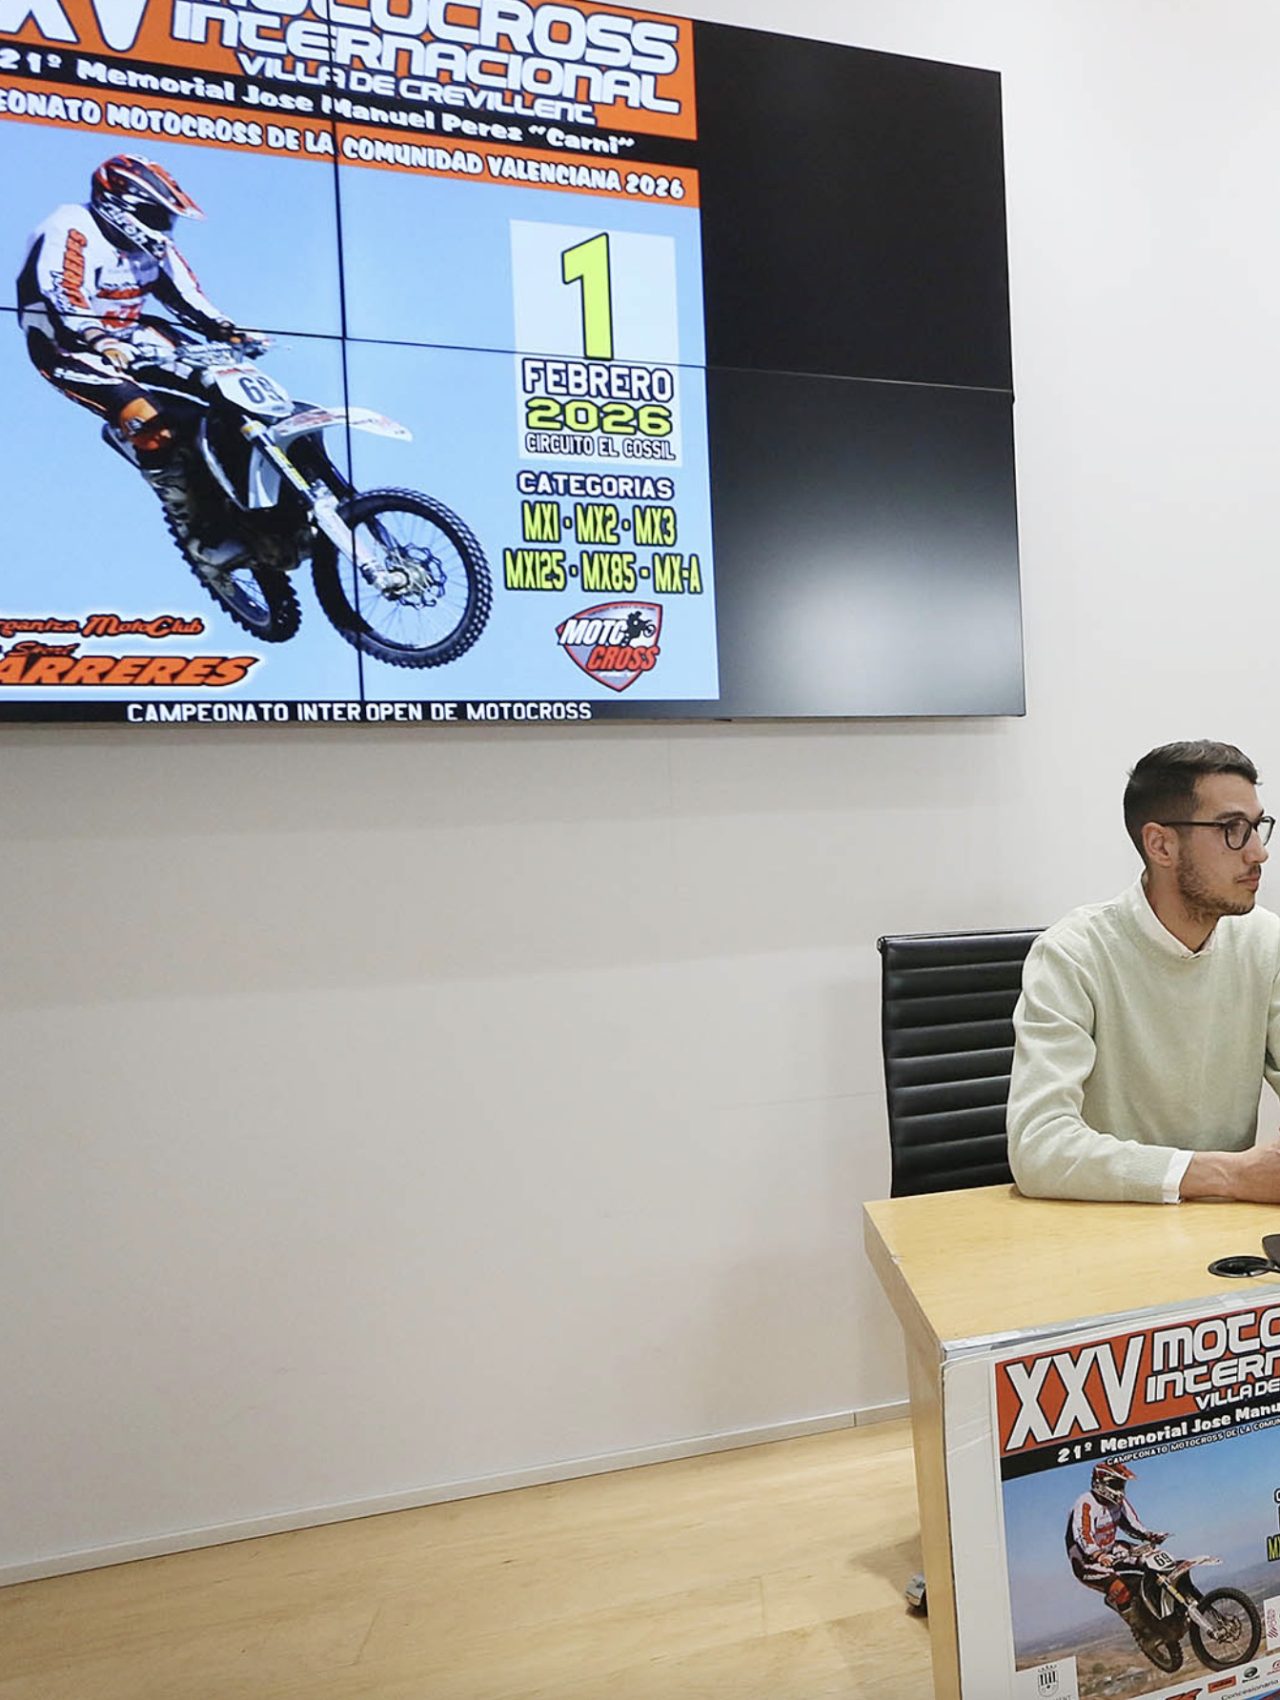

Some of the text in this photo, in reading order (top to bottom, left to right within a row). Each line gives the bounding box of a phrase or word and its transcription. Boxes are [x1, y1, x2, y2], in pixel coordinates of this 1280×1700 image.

[171, 0, 681, 114] INTERNACIONAL
[76, 59, 235, 101] Memorial
[242, 86, 314, 112] Jose
[321, 95, 435, 130] Manuel
[443, 112, 524, 142] Perez
[237, 53, 596, 125] VILLA DE CREVILLENT
[106, 103, 263, 146] MOTOCROSS
[266, 126, 300, 151] DE
[305, 133, 336, 156] LA
[342, 136, 483, 175] COMUNIDAD
[486, 155, 621, 191] VALENCIANA
[626, 173, 684, 199] 2026
[562, 232, 614, 361] 1
[522, 358, 674, 401] FEBRERO
[526, 397, 672, 436] 2026
[525, 432, 594, 455] CIRCUITO
[597, 436, 619, 458] EL
[517, 470, 675, 500] CATEGORIAS
[574, 502, 619, 545] MX2
[632, 505, 677, 547] MX3
[580, 550, 636, 593] MX85
[586, 645, 660, 672] CROSS
[127, 702, 592, 723] CAMPEONATO INTER OPEN DE MOTOCROSS
[1004, 1334, 1145, 1451] XXV
[1195, 1384, 1252, 1411] VILLA
[1255, 1378, 1280, 1397] DE
[1101, 1421, 1187, 1453] Memorial
[1191, 1414, 1231, 1434] Jose
[1106, 1445, 1168, 1466] CAMPEONATO
[1170, 1433, 1224, 1452] MOTOCROSS
[1226, 1428, 1238, 1440] DE
[1239, 1425, 1252, 1435] LA
[1153, 1552, 1172, 1567] 69
